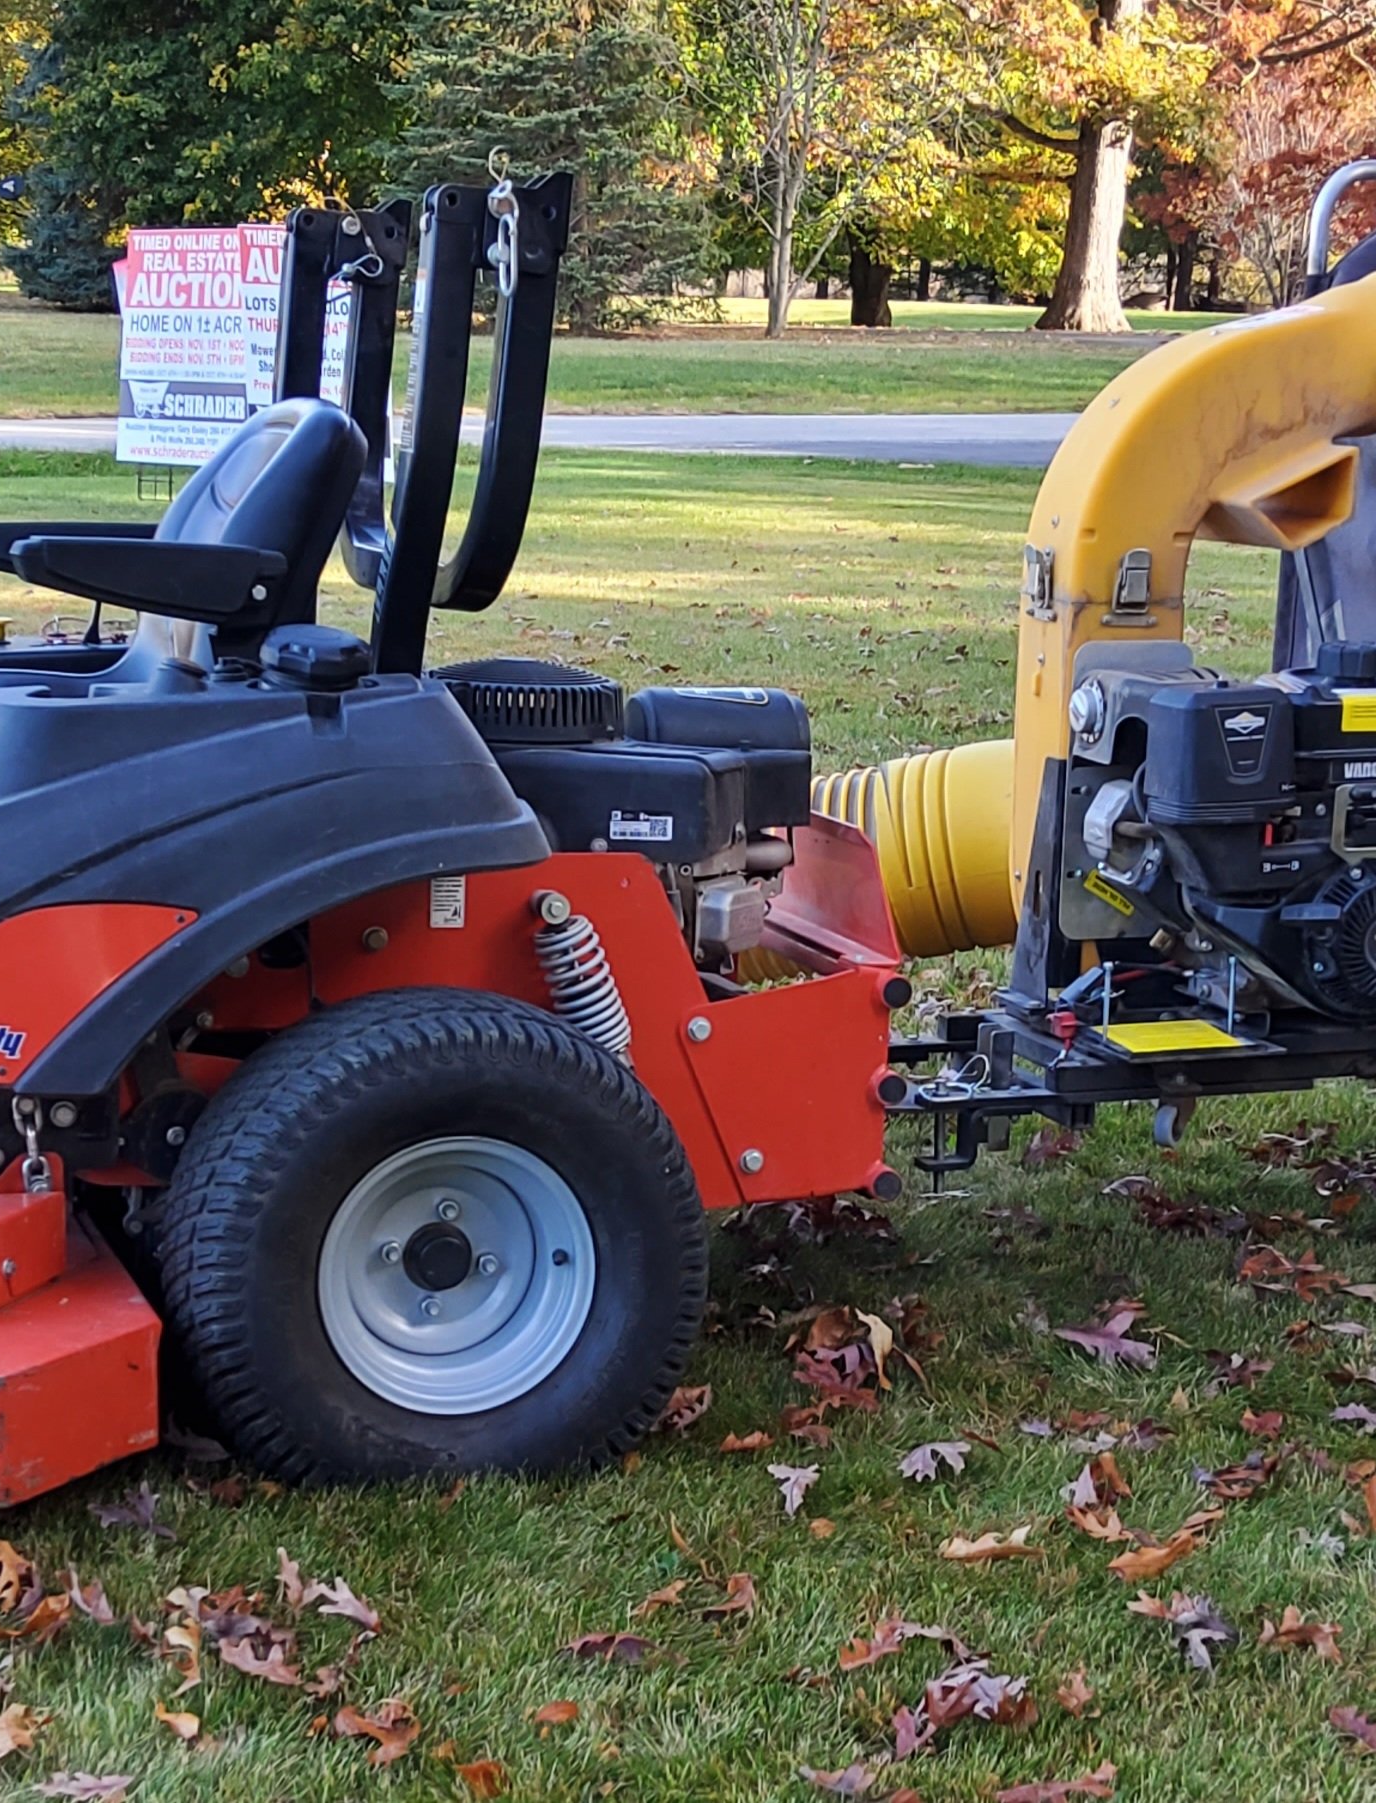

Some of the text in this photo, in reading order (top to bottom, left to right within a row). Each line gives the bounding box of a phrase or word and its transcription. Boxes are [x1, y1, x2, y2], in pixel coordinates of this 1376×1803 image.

[132, 235, 172, 251] TIMED
[174, 234, 222, 251] ONLINE
[143, 252, 241, 272] REAL ESTATE
[245, 296, 277, 312] LOTS
[130, 314, 169, 332] HOME
[173, 315, 193, 333] ON
[213, 315, 242, 334] ACR
[163, 352, 184, 364] ENDS
[164, 393, 246, 420] SCHRADER
